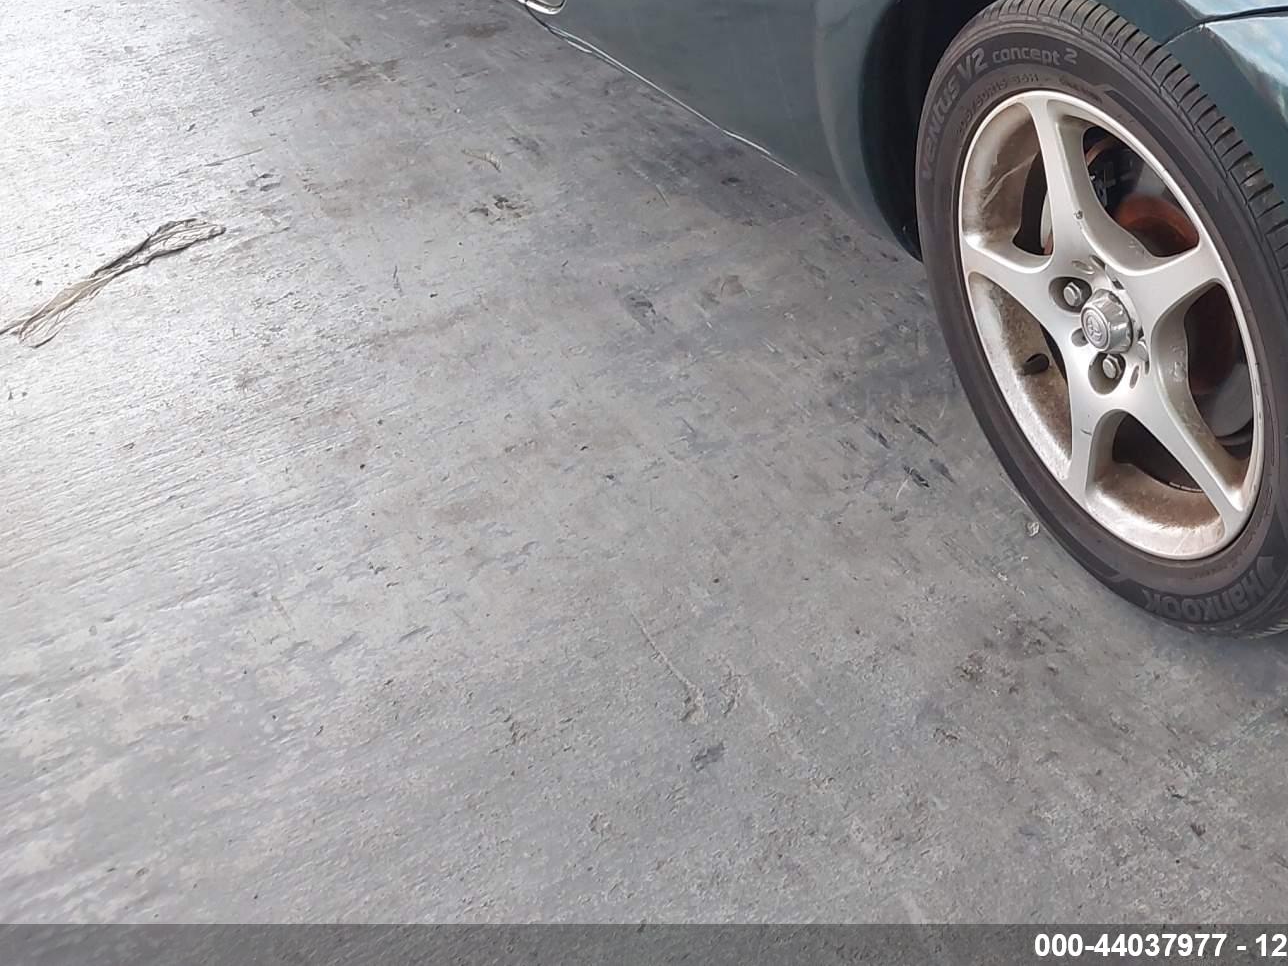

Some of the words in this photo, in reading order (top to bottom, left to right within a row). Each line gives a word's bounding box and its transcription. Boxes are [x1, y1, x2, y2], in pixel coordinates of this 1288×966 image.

[957, 47, 988, 80] V2
[992, 47, 1060, 66] concept
[1063, 47, 1079, 65] 2
